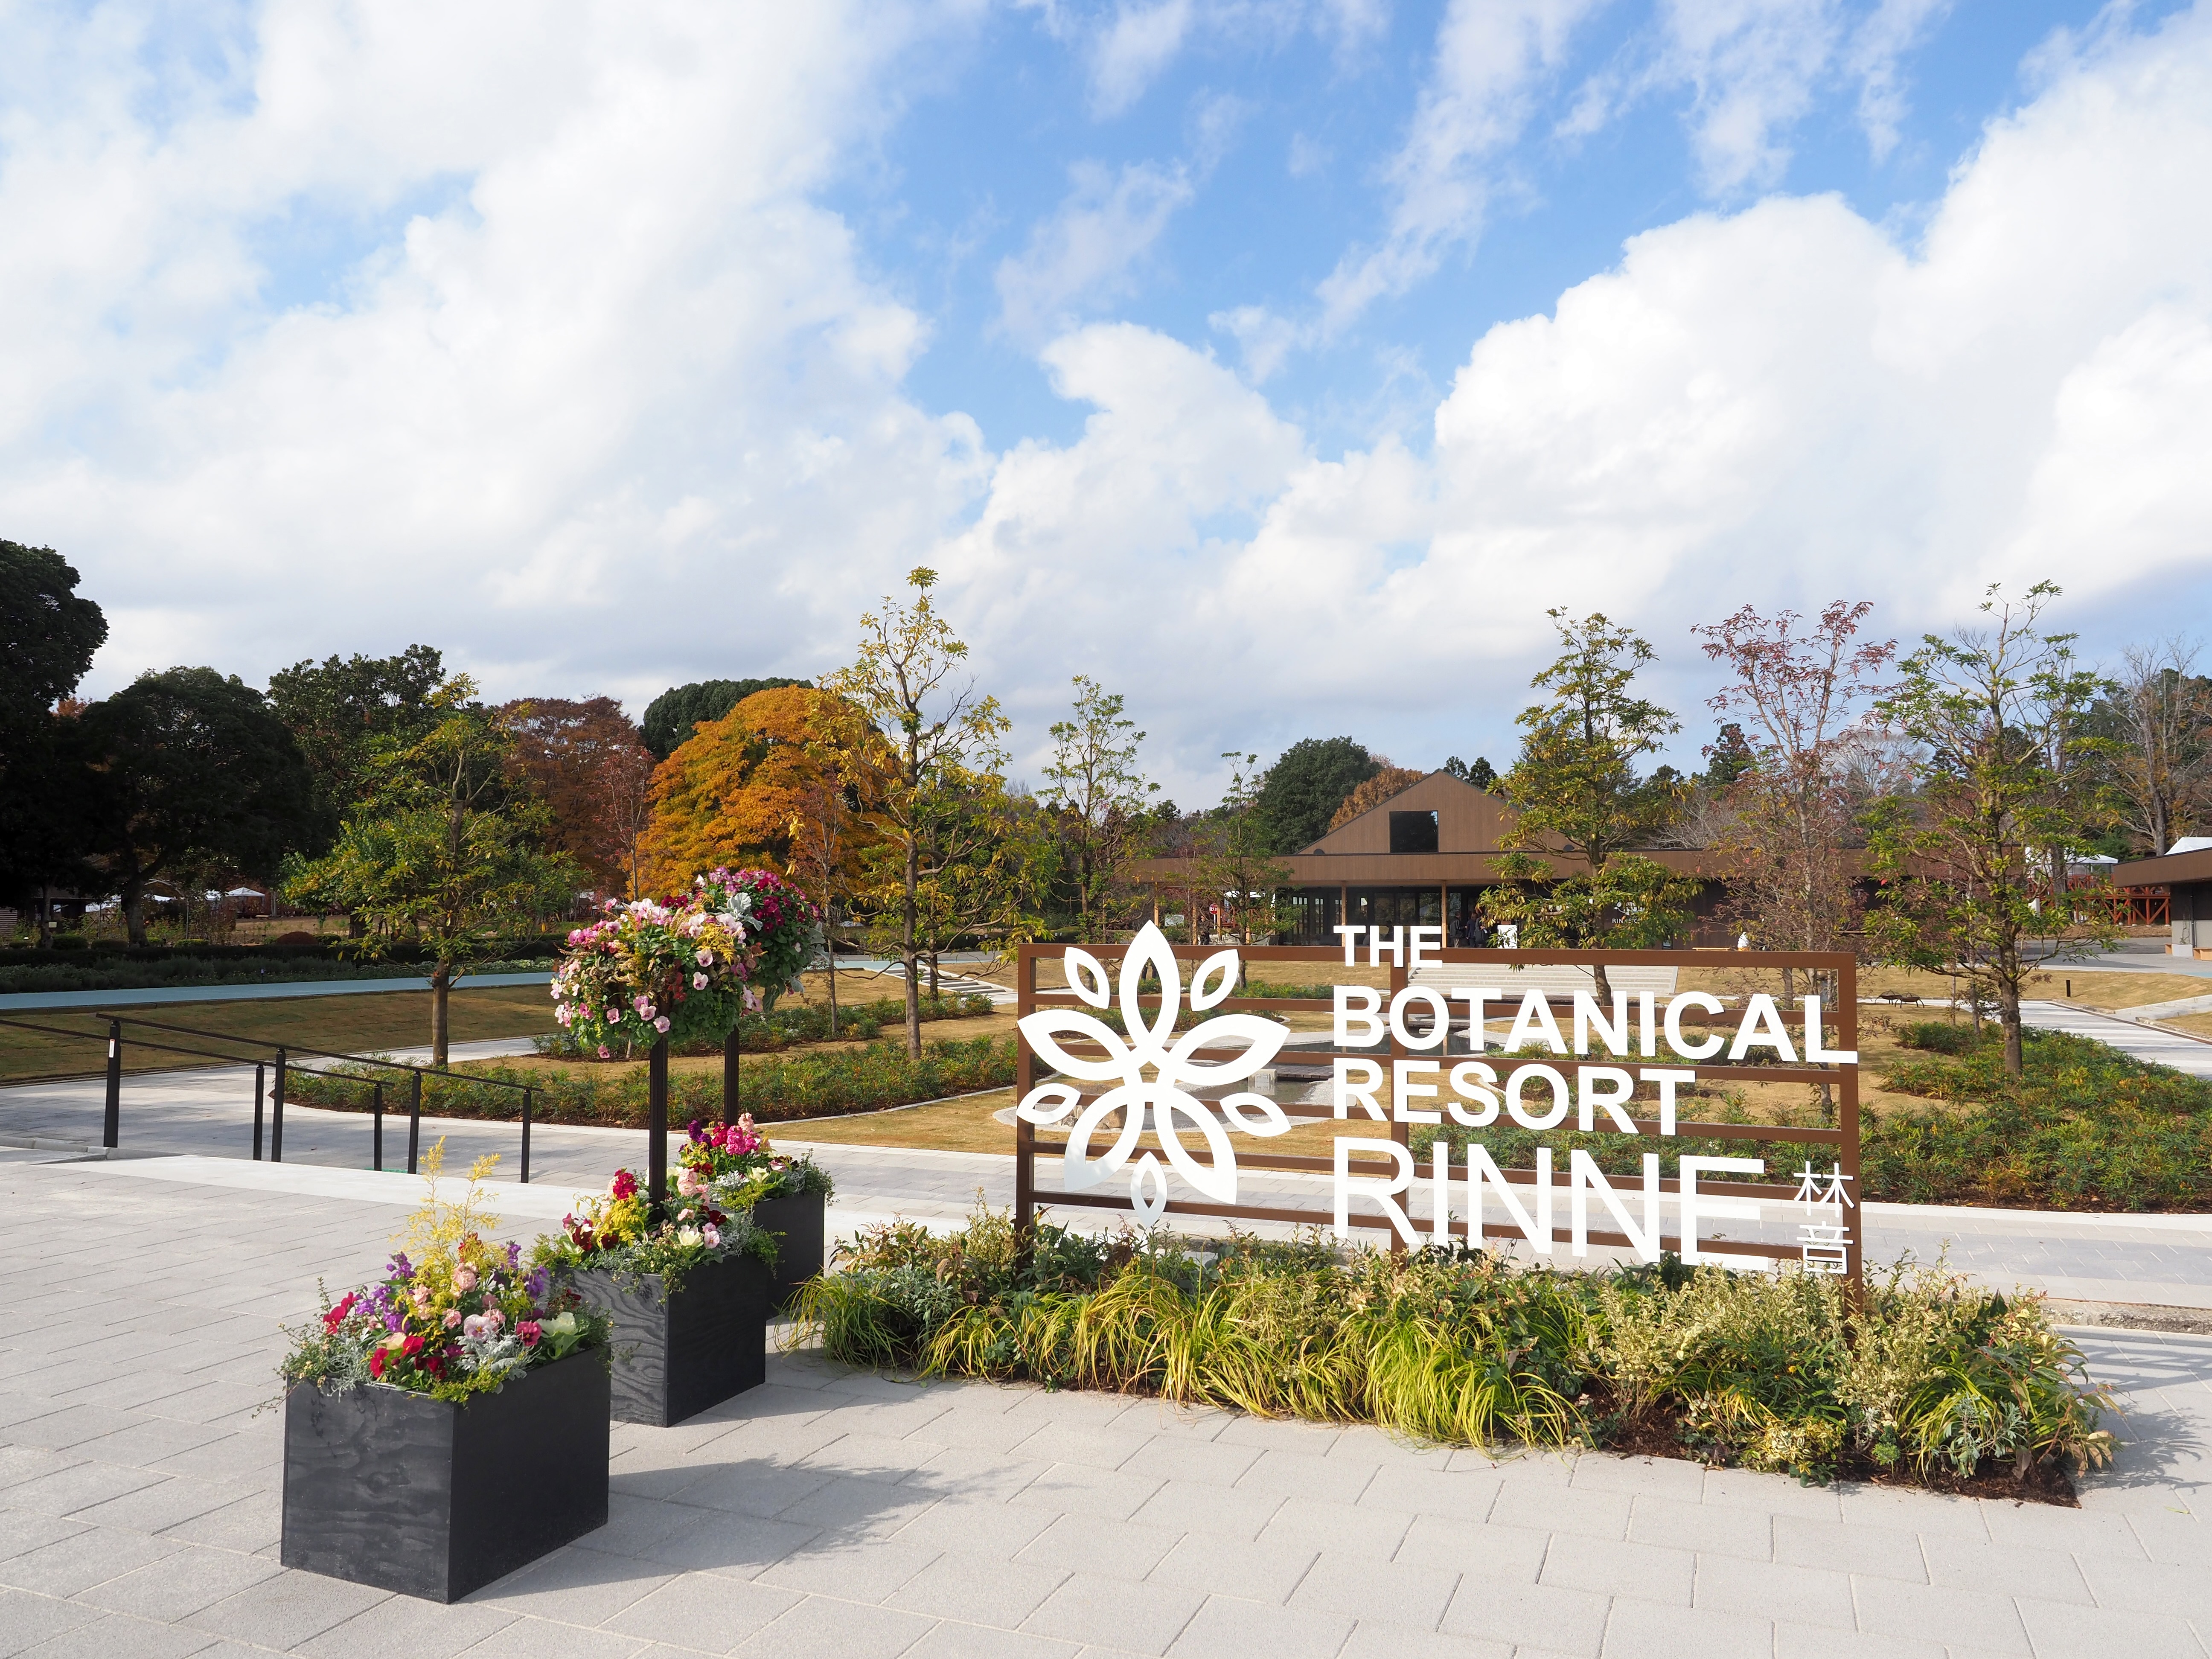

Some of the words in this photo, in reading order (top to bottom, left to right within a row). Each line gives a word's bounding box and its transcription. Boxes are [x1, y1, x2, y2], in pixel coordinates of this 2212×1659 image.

[1333, 925, 1443, 968] THE
[1333, 985, 1857, 1064] BOTANICAL
[1334, 1058, 1695, 1135] RESORT
[1334, 1138, 1768, 1271] RINNE
[1793, 1161, 1854, 1274] 林音
